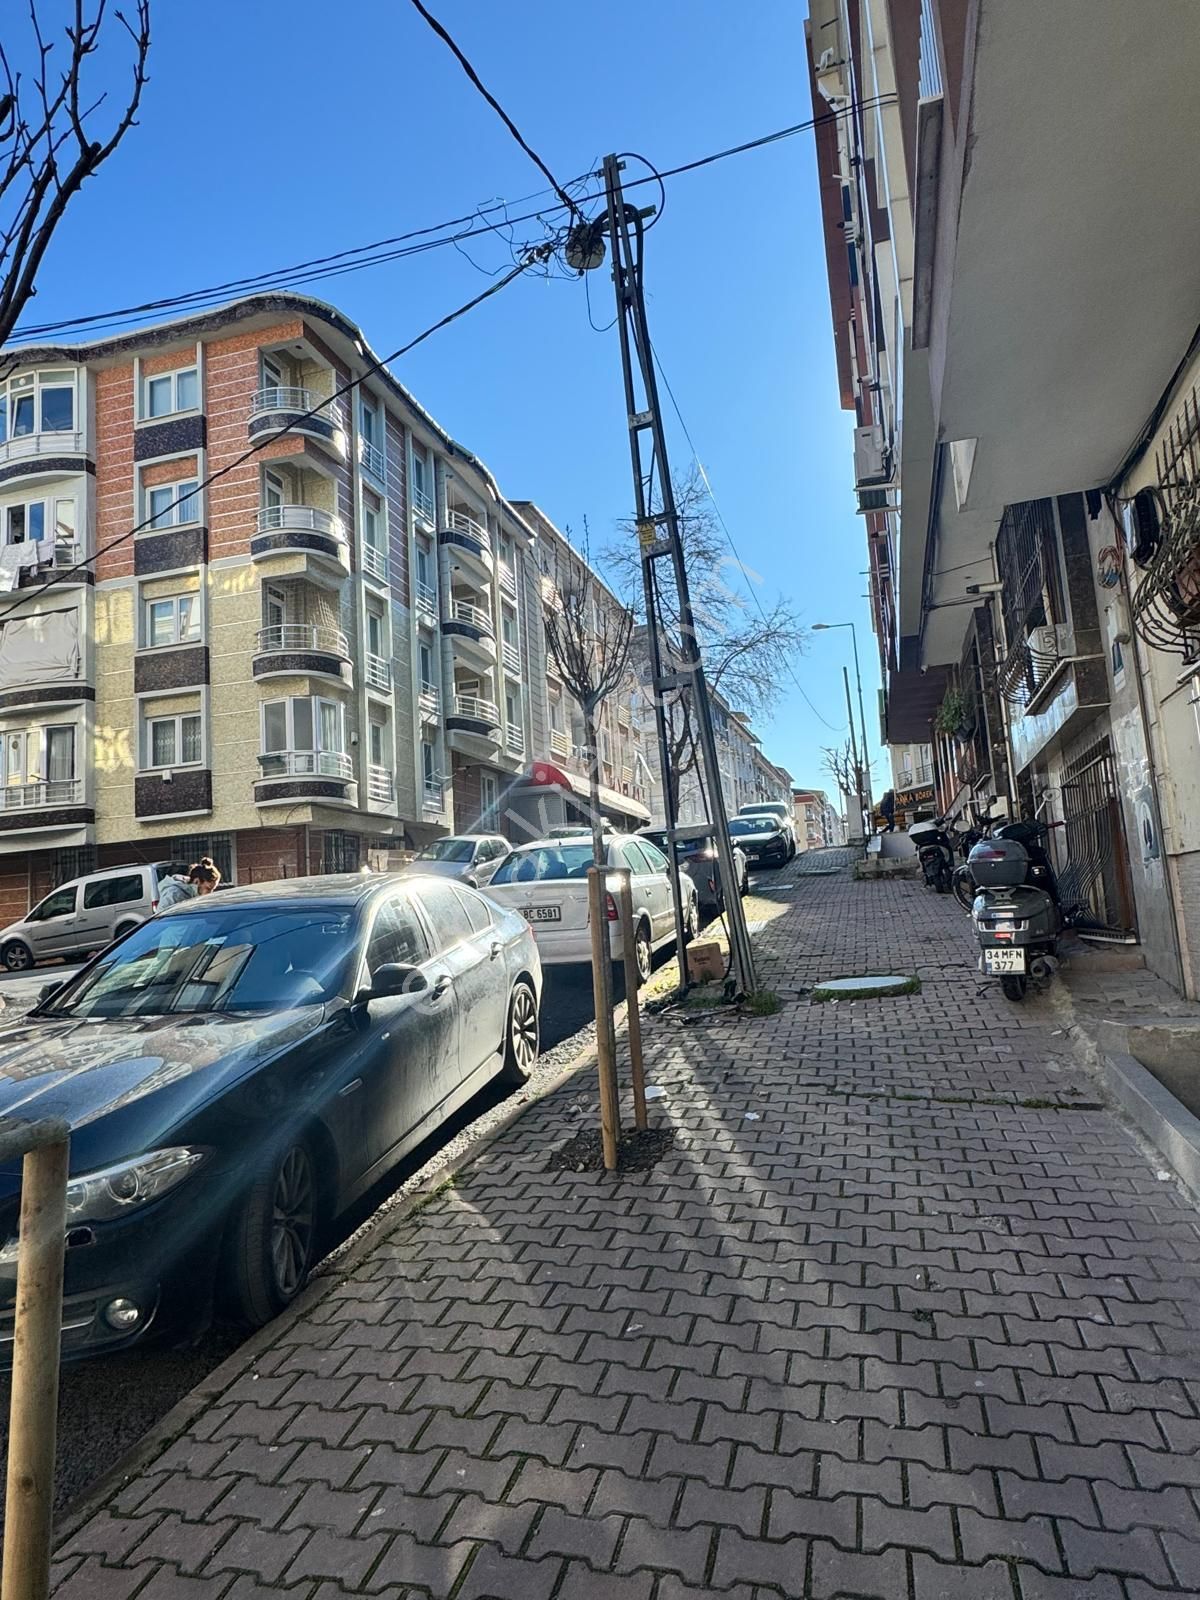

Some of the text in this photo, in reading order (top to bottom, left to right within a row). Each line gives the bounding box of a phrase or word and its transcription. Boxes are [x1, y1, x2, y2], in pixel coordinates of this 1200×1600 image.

[986, 950, 1022, 960] 34 MFN
[994, 960, 1014, 970] 377
